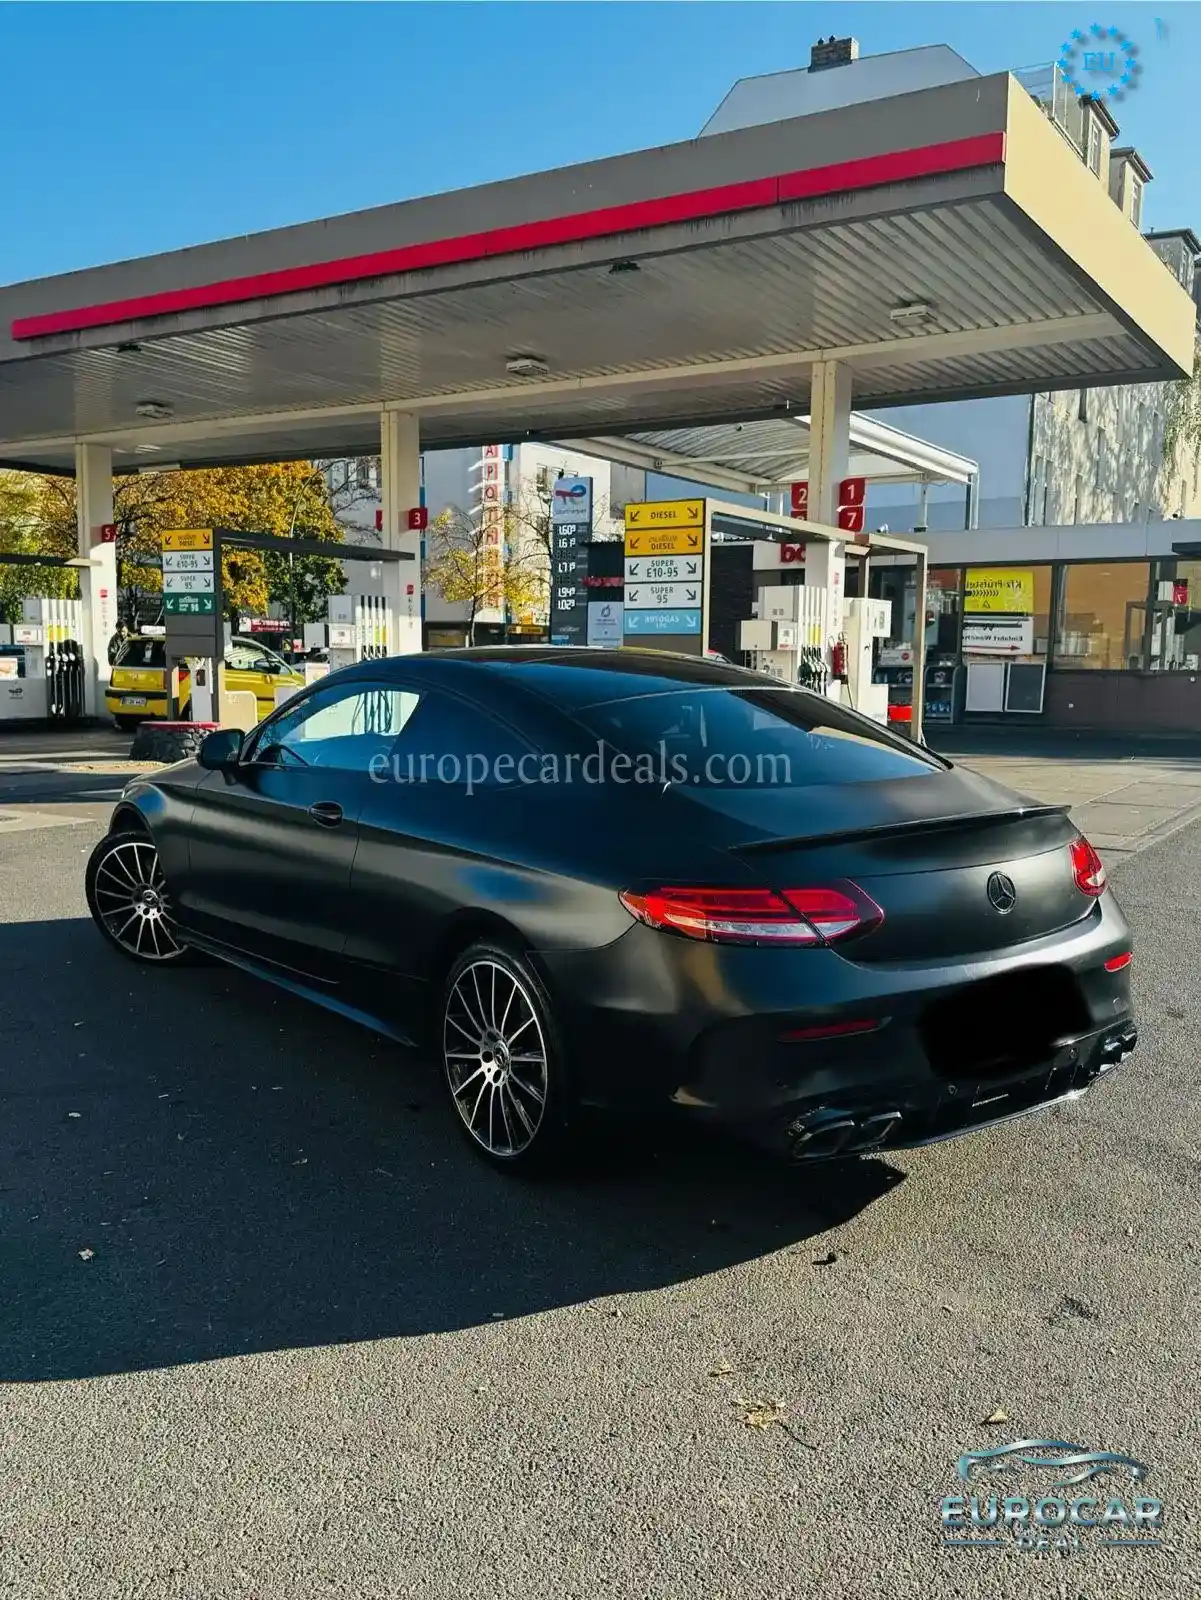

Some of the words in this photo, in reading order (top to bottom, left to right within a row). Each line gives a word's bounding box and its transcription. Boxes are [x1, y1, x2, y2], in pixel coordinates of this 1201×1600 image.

[798, 488, 807, 504] 2
[847, 484, 855, 499] 1
[414, 512, 421, 525] 3
[650, 510, 678, 519] DIESEL
[847, 512, 857, 528] 7
[105, 528, 111, 540] 5
[651, 542, 676, 550] DIESEL
[646, 567, 679, 578] E10-95
[656, 594, 668, 604] 95
